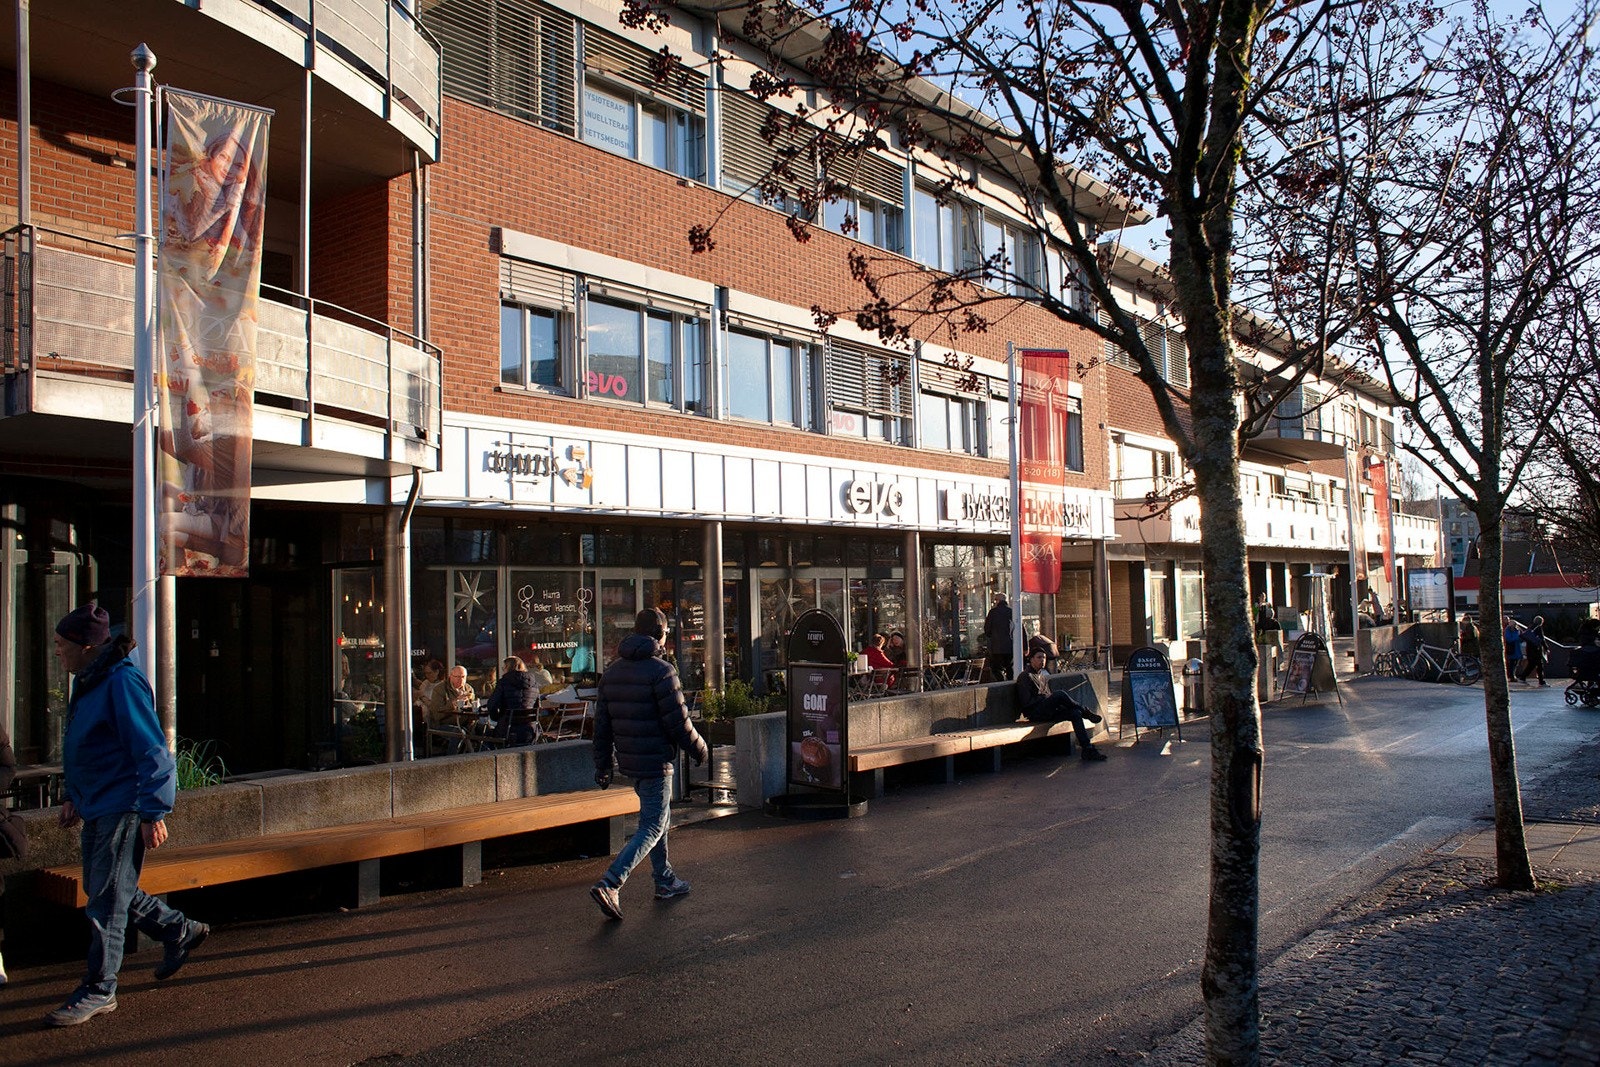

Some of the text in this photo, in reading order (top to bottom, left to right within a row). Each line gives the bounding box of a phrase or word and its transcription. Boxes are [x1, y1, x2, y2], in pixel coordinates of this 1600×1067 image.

[585, 369, 628, 398] evo
[1027, 374, 1063, 395] RØA
[833, 413, 856, 431] vo
[1043, 467, 1061, 479] (18)
[840, 479, 908, 517] evo
[962, 492, 1012, 523] BAKE
[1023, 541, 1058, 564] RØA
[556, 641, 579, 649] HANSEN
[803, 693, 828, 712] GOAT
